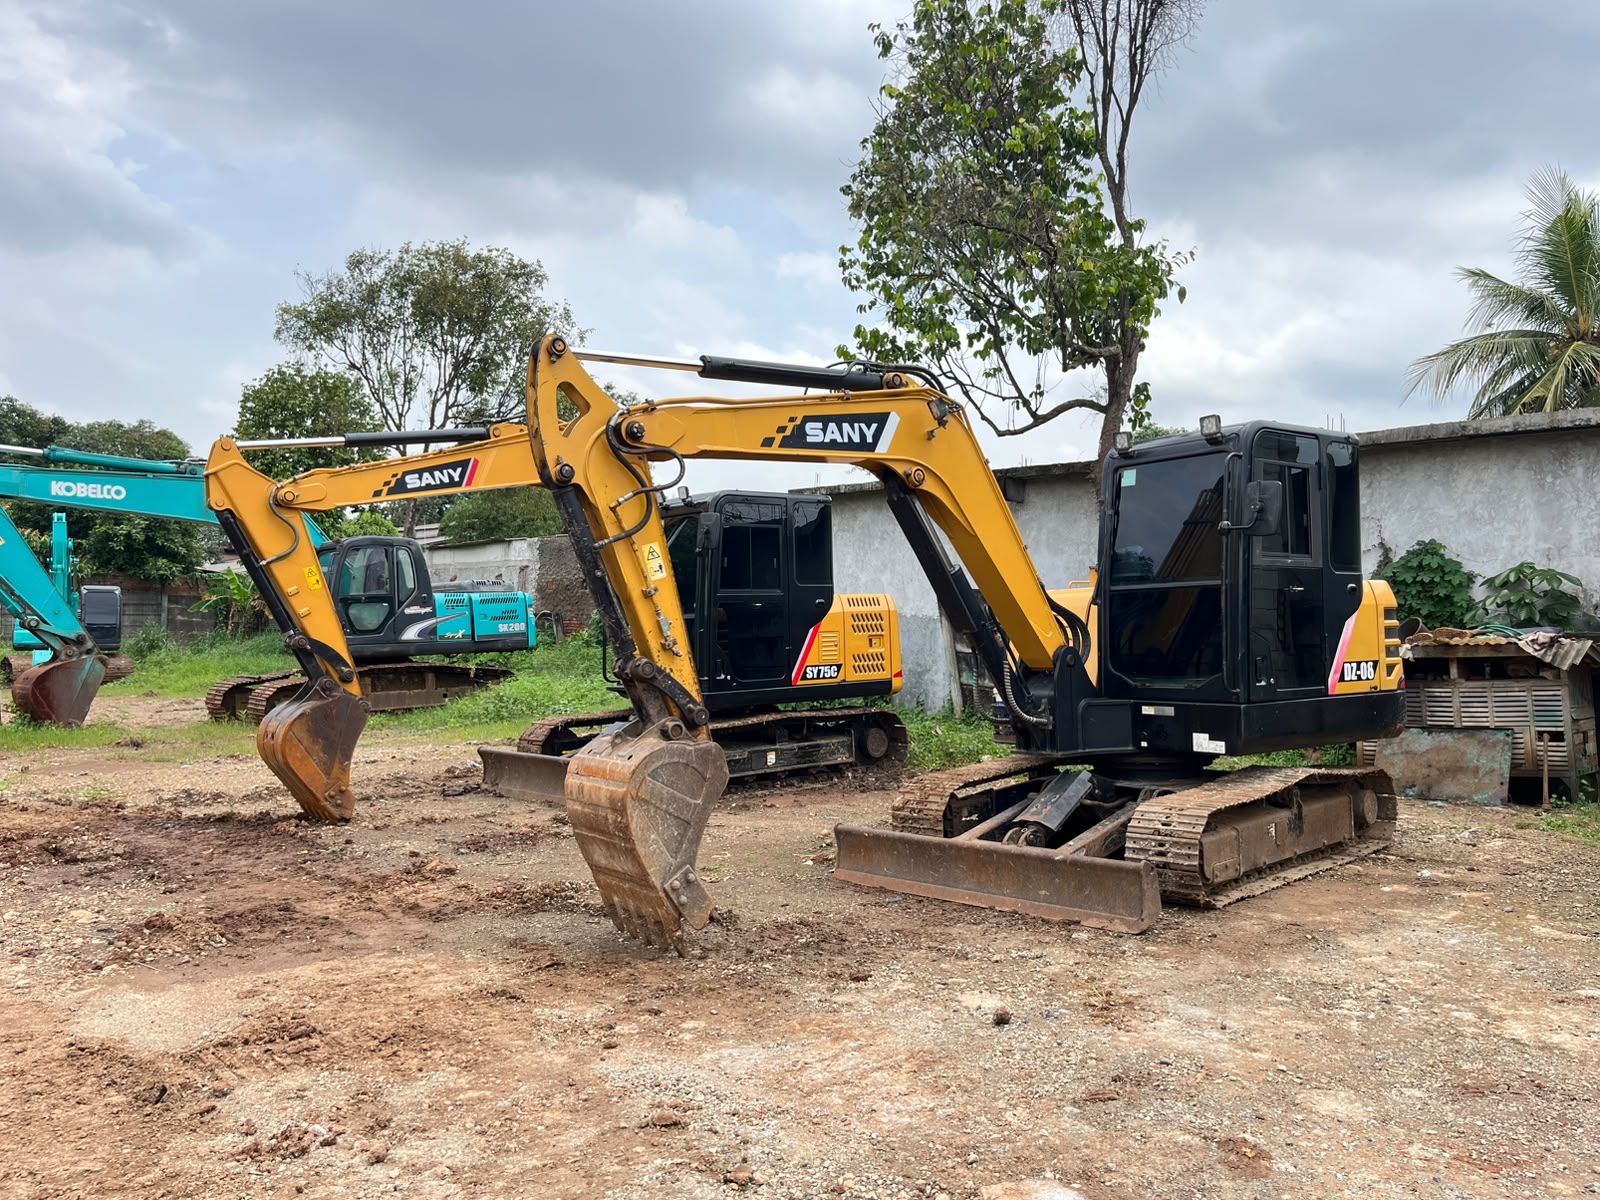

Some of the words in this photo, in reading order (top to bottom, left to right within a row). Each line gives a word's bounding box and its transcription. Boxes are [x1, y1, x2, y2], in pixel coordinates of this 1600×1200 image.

[804, 422, 878, 443] SANY
[405, 467, 462, 489] SANY
[51, 480, 127, 500] KOBELCO
[498, 622, 526, 632] SK200
[806, 665, 838, 679] SY75C
